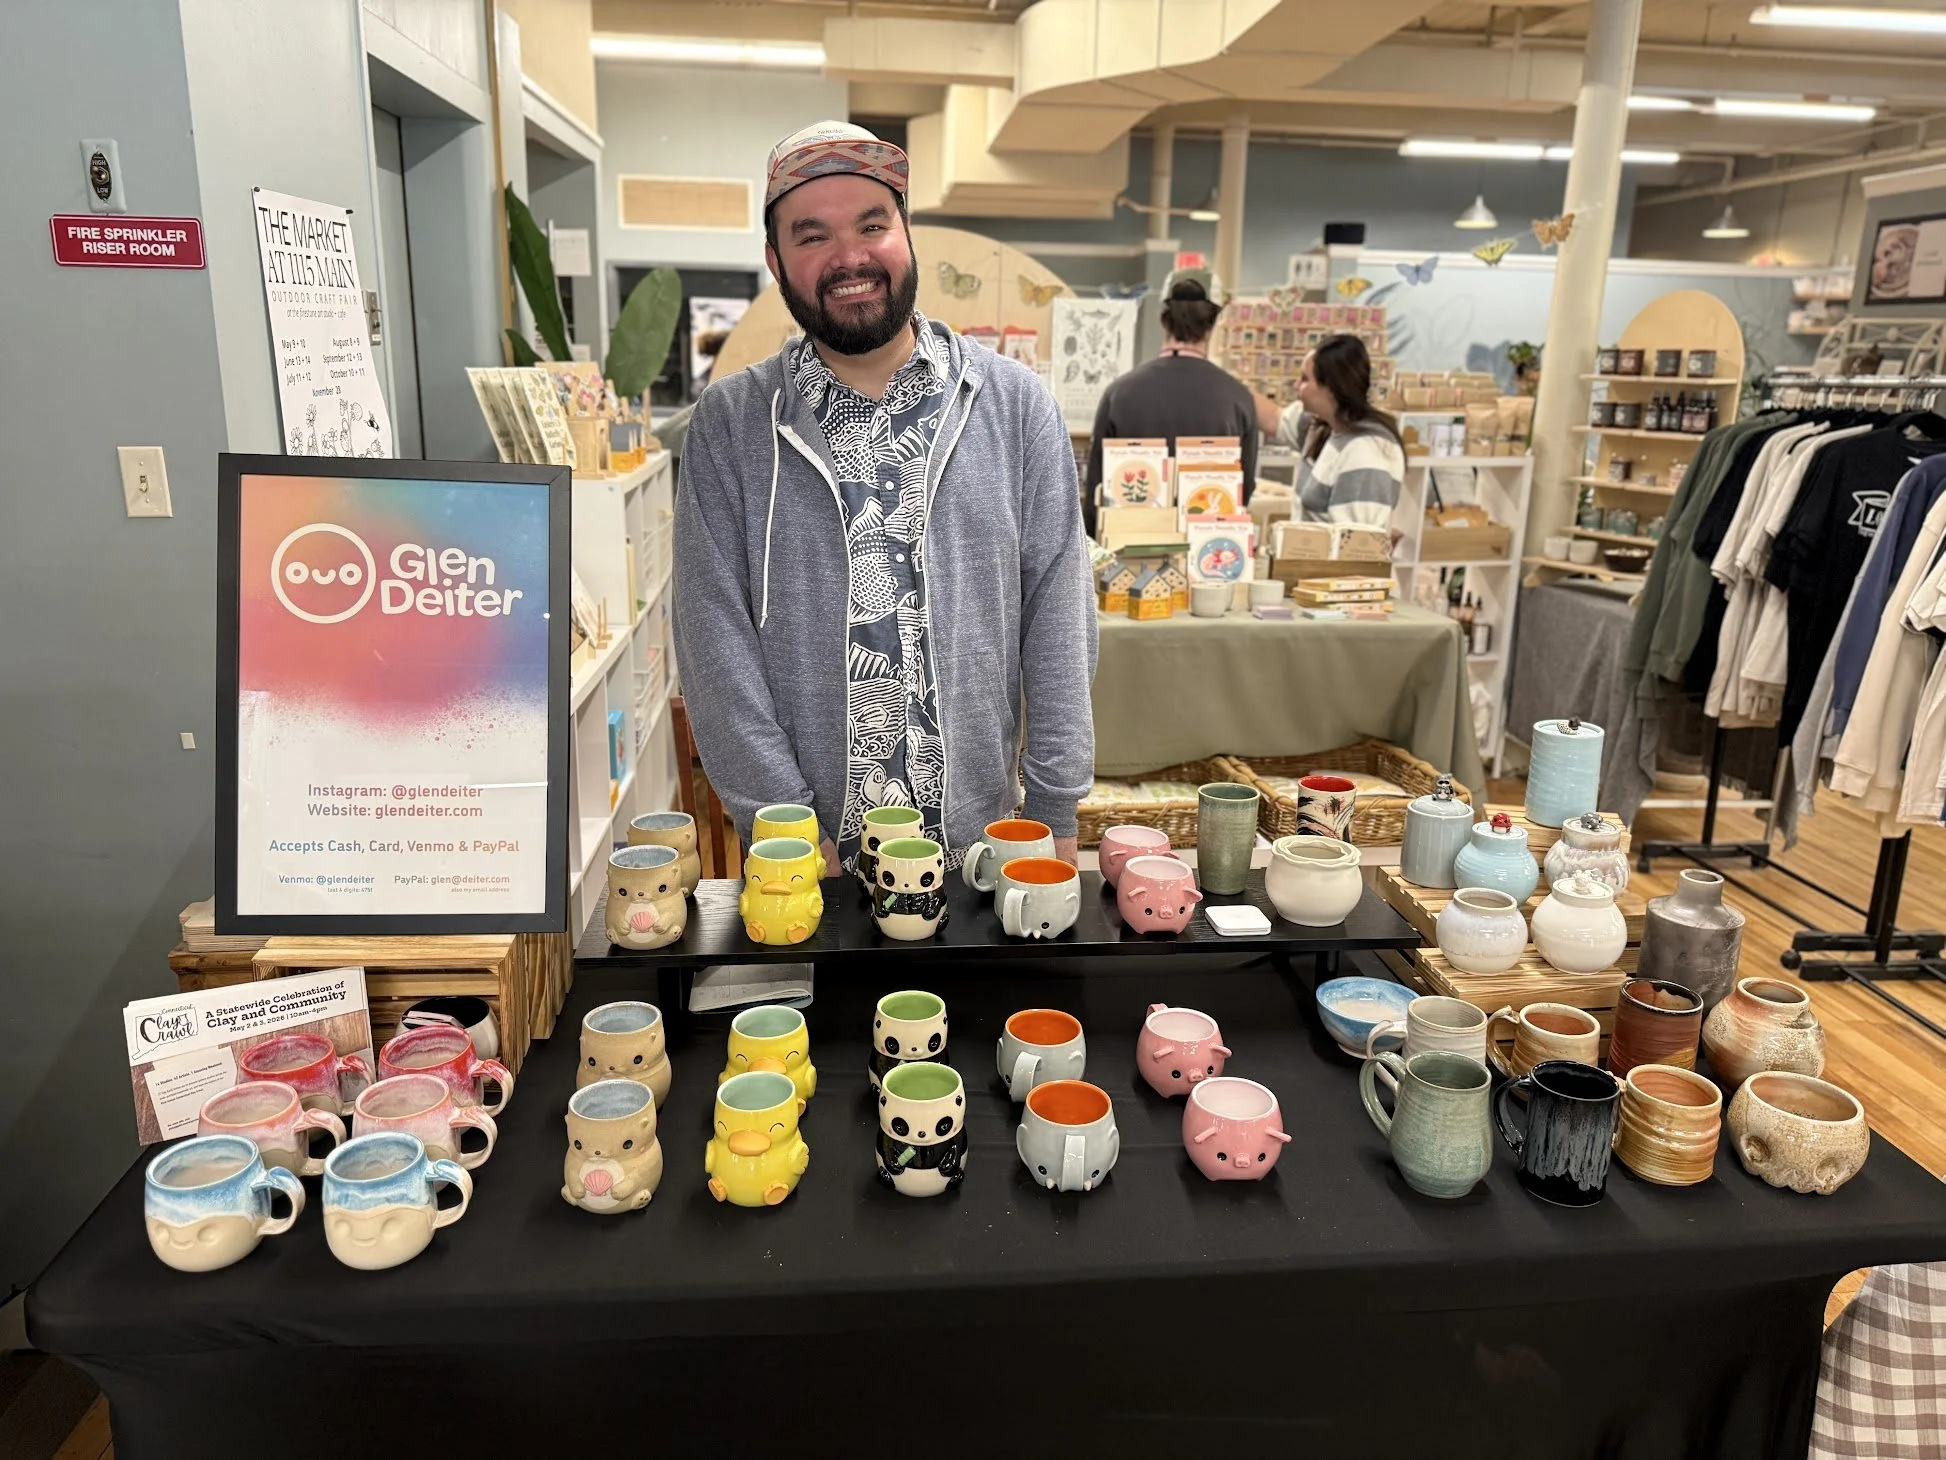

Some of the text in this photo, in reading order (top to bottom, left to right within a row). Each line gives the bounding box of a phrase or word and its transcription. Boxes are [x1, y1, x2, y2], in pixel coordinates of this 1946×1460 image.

[67, 226, 188, 243] FIRE SPRINKLER
[258, 206, 348, 254] THE MARKET
[82, 242, 176, 257] RISER ROOM
[268, 249, 356, 289] AT 1115 MAIN
[271, 290, 358, 306] OUTDOOR CRAFT FAIR
[281, 339, 292, 352] May
[292, 339, 296, 349] 9
[332, 337, 349, 350] August
[283, 356, 295, 368] June
[295, 356, 301, 366] 13
[305, 355, 311, 365] 14
[322, 353, 346, 365] September
[346, 352, 352, 362] 12
[356, 352, 363, 362] 13
[286, 374, 296, 387] July
[296, 373, 302, 383] 11
[305, 372, 312, 382] 12
[330, 368, 348, 379] October
[348, 368, 355, 378] 10
[358, 367, 365, 377] 11
[312, 386, 334, 397] November
[390, 543, 496, 586] Glen
[380, 578, 524, 617] Deiter
[308, 784, 484, 801] Instagram: @glendeiter
[307, 804, 483, 820] Website: glendeiter.com
[269, 840, 520, 855] Accepts Cash, Card, Venmo & PayPal
[279, 874, 375, 886] Venmo: @glendeiter
[394, 875, 510, 886] PayPal: glen@deiter.com
[205, 980, 345, 1019] A Statewide Celebration of
[207, 990, 347, 1028] Clay and Community
[229, 1024, 246, 1033] May
[267, 1015, 285, 1024] 2026
[290, 1005, 328, 1019] 10am-4pm
